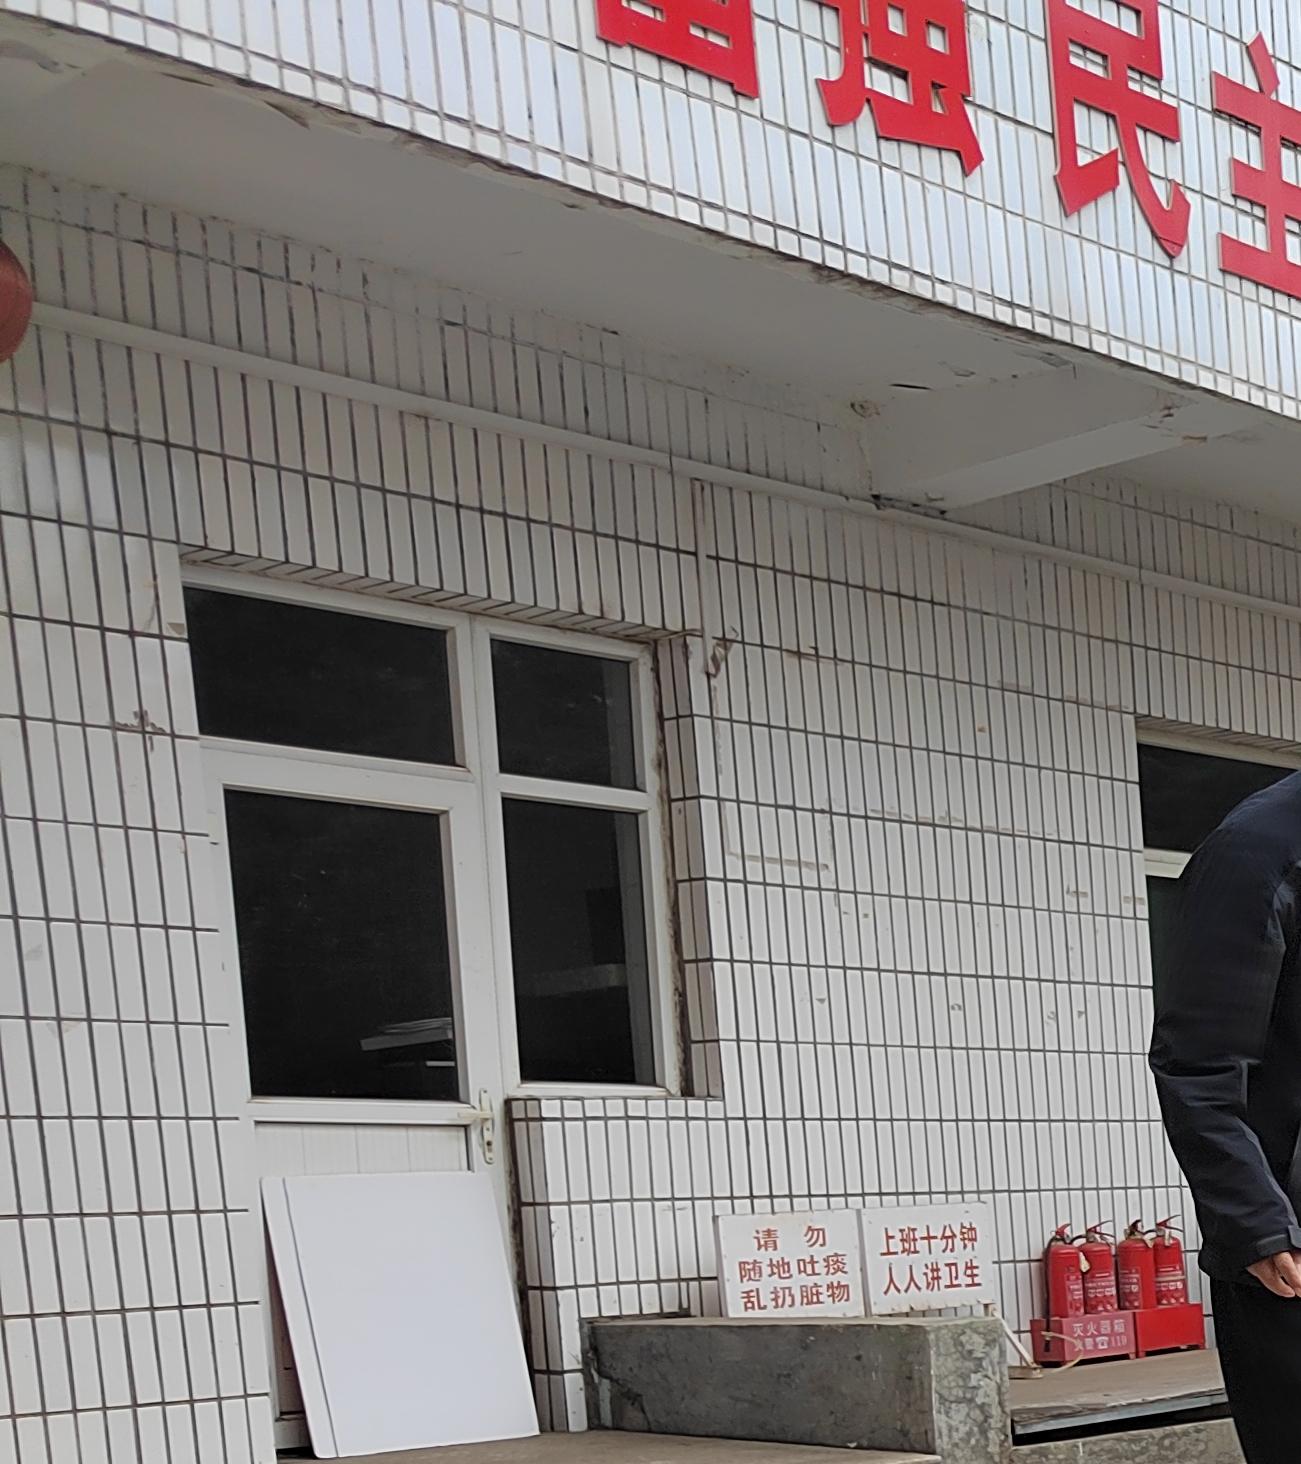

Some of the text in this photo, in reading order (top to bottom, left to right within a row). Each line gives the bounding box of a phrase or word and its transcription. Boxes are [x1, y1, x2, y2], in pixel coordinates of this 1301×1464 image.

[879, 1221, 978, 1257] 上班十分钟
[738, 1252, 849, 1283] 随地吐痰
[883, 1258, 982, 1296] 人人讲卫生
[741, 1280, 851, 1312] 乱扔脏物
[1072, 1319, 1126, 1337] 灭火器箱
